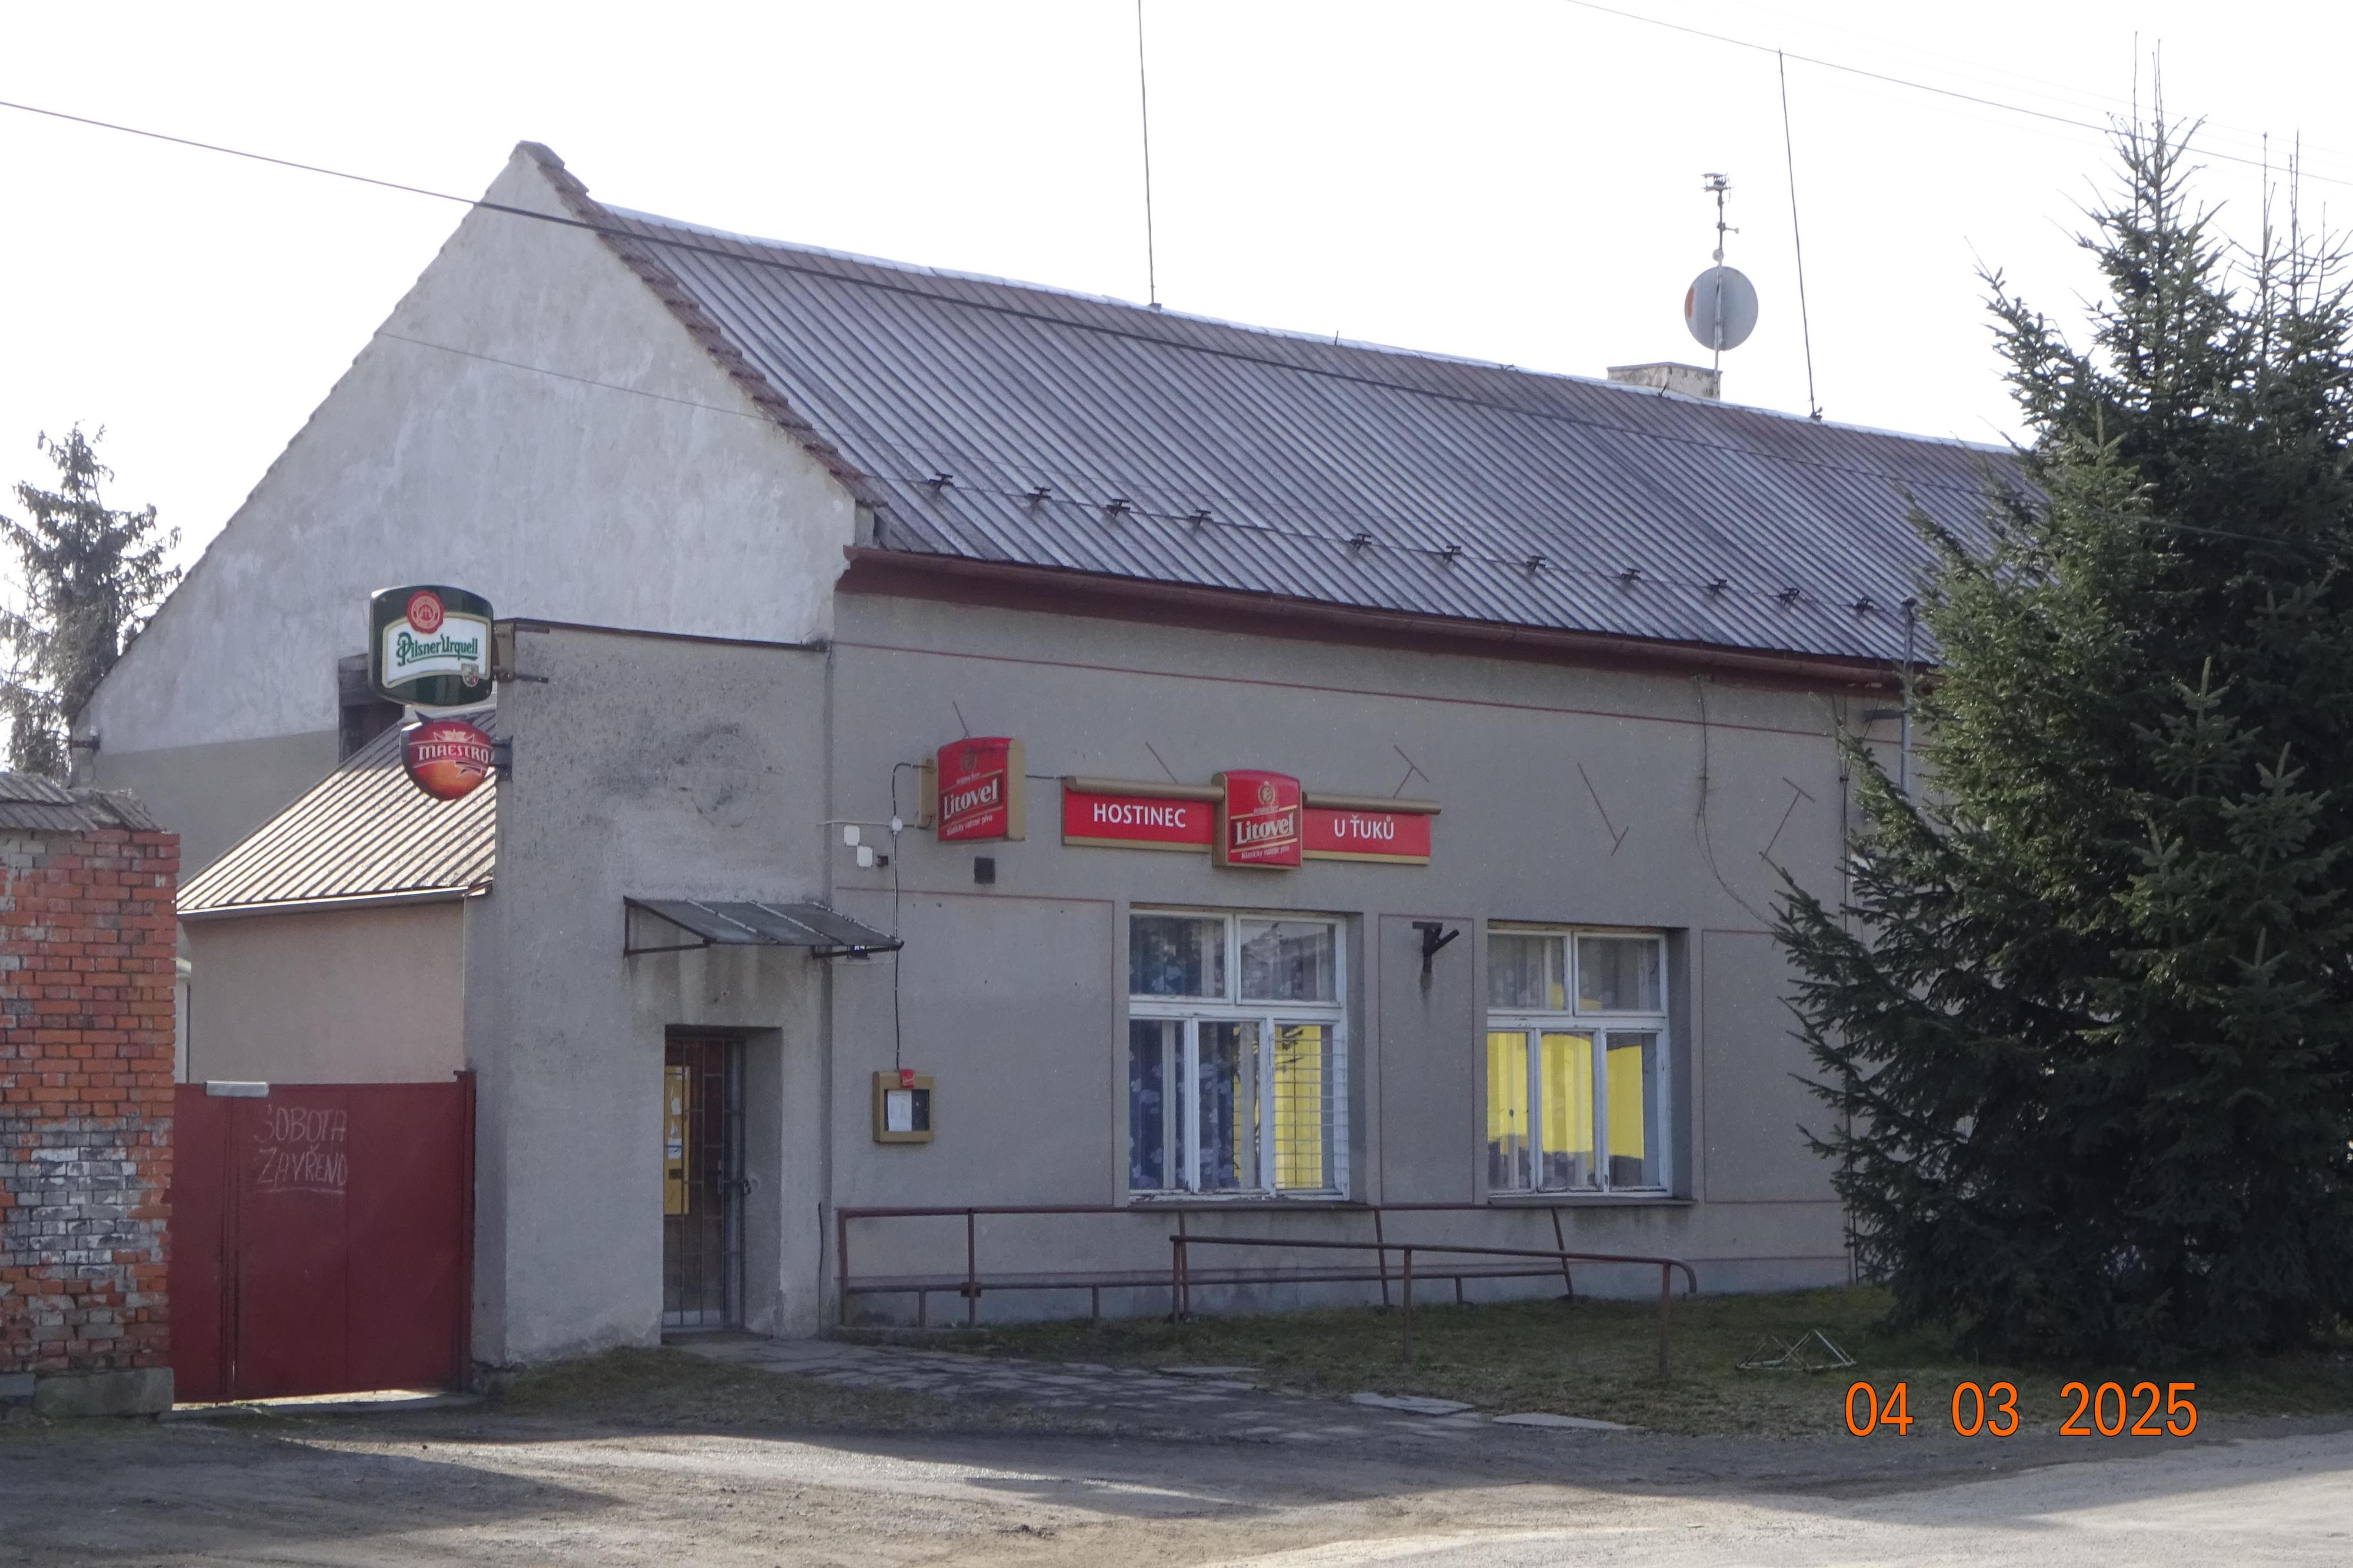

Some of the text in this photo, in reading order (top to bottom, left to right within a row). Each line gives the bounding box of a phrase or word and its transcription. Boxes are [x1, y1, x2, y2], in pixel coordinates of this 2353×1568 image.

[396, 632, 478, 666] Pilsner Urquell
[419, 745, 489, 764] MAESTRO
[944, 778, 998, 820] Litovel
[1094, 803, 1186, 828] HOSTINEC
[1236, 812, 1294, 845] Litovel
[1334, 814, 1394, 840] U ŤUKŮ
[254, 1105, 348, 1143] SOBOTA
[258, 1143, 348, 1186] ZAVŘENO
